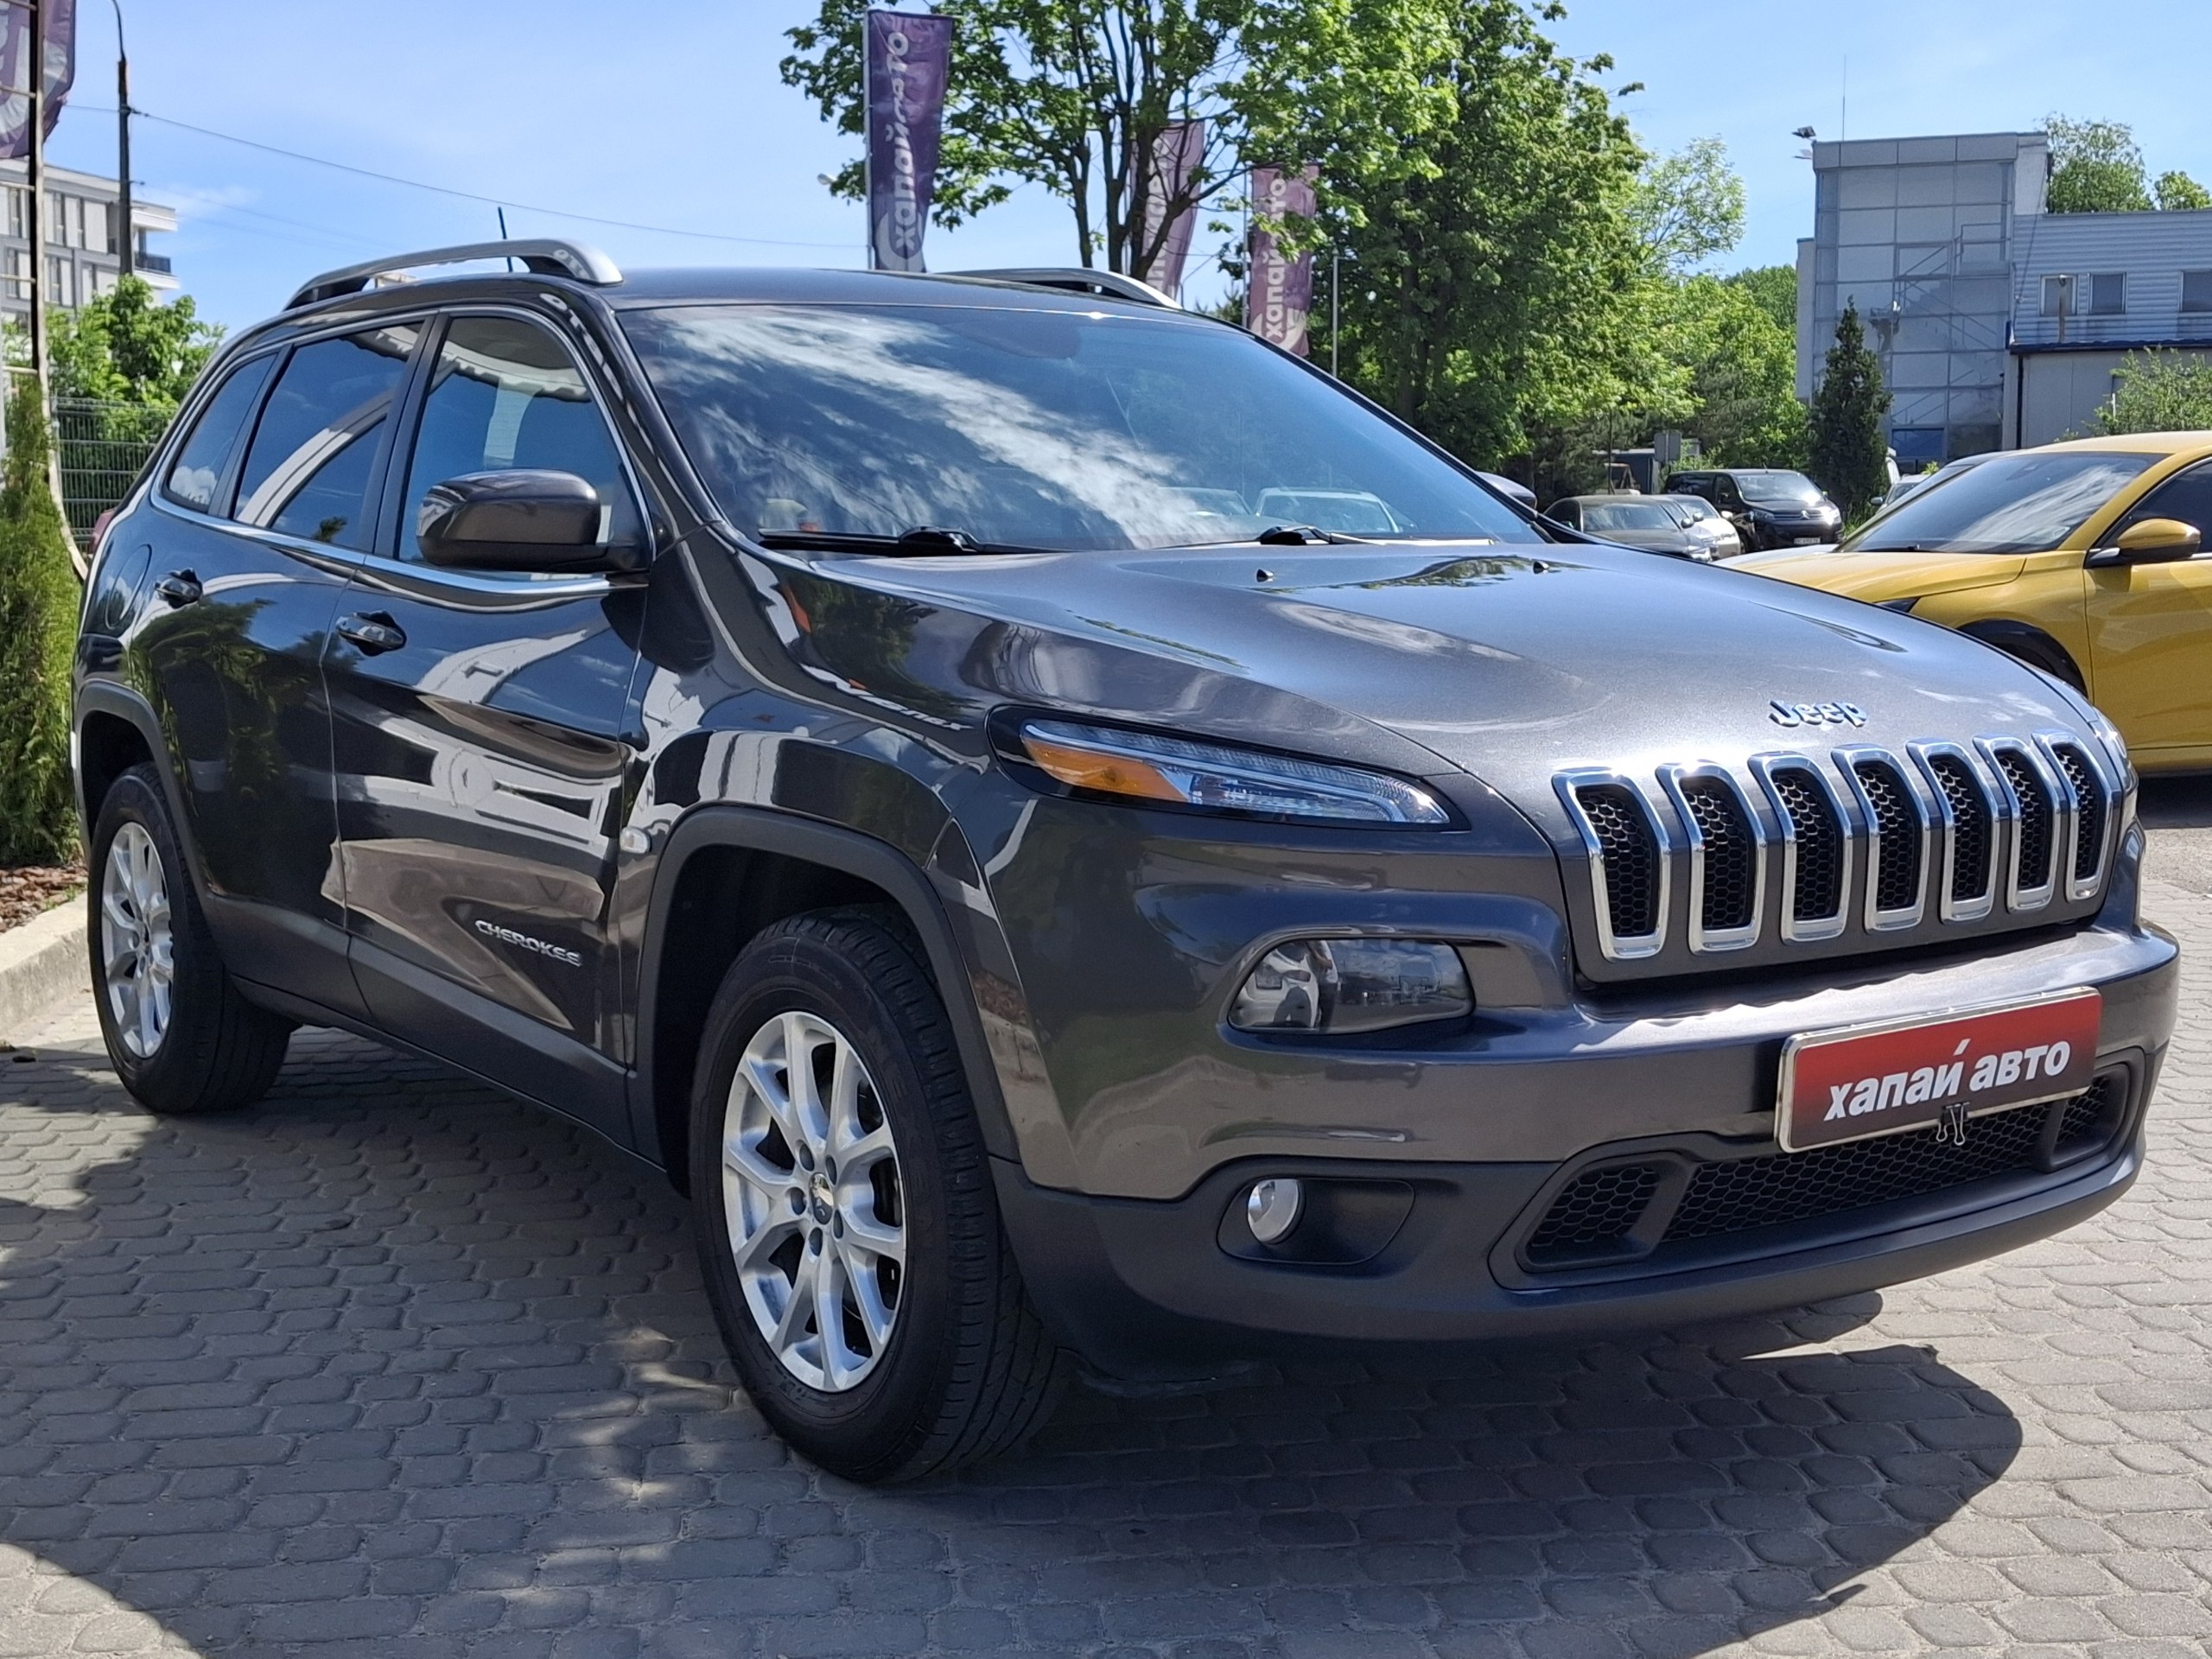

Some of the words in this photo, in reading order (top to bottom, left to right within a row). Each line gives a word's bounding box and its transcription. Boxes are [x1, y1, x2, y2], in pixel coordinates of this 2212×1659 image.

[1768, 699, 1867, 728] Jeep
[475, 919, 582, 967] CHEROKEE
[1968, 1040, 2071, 1093] авто
